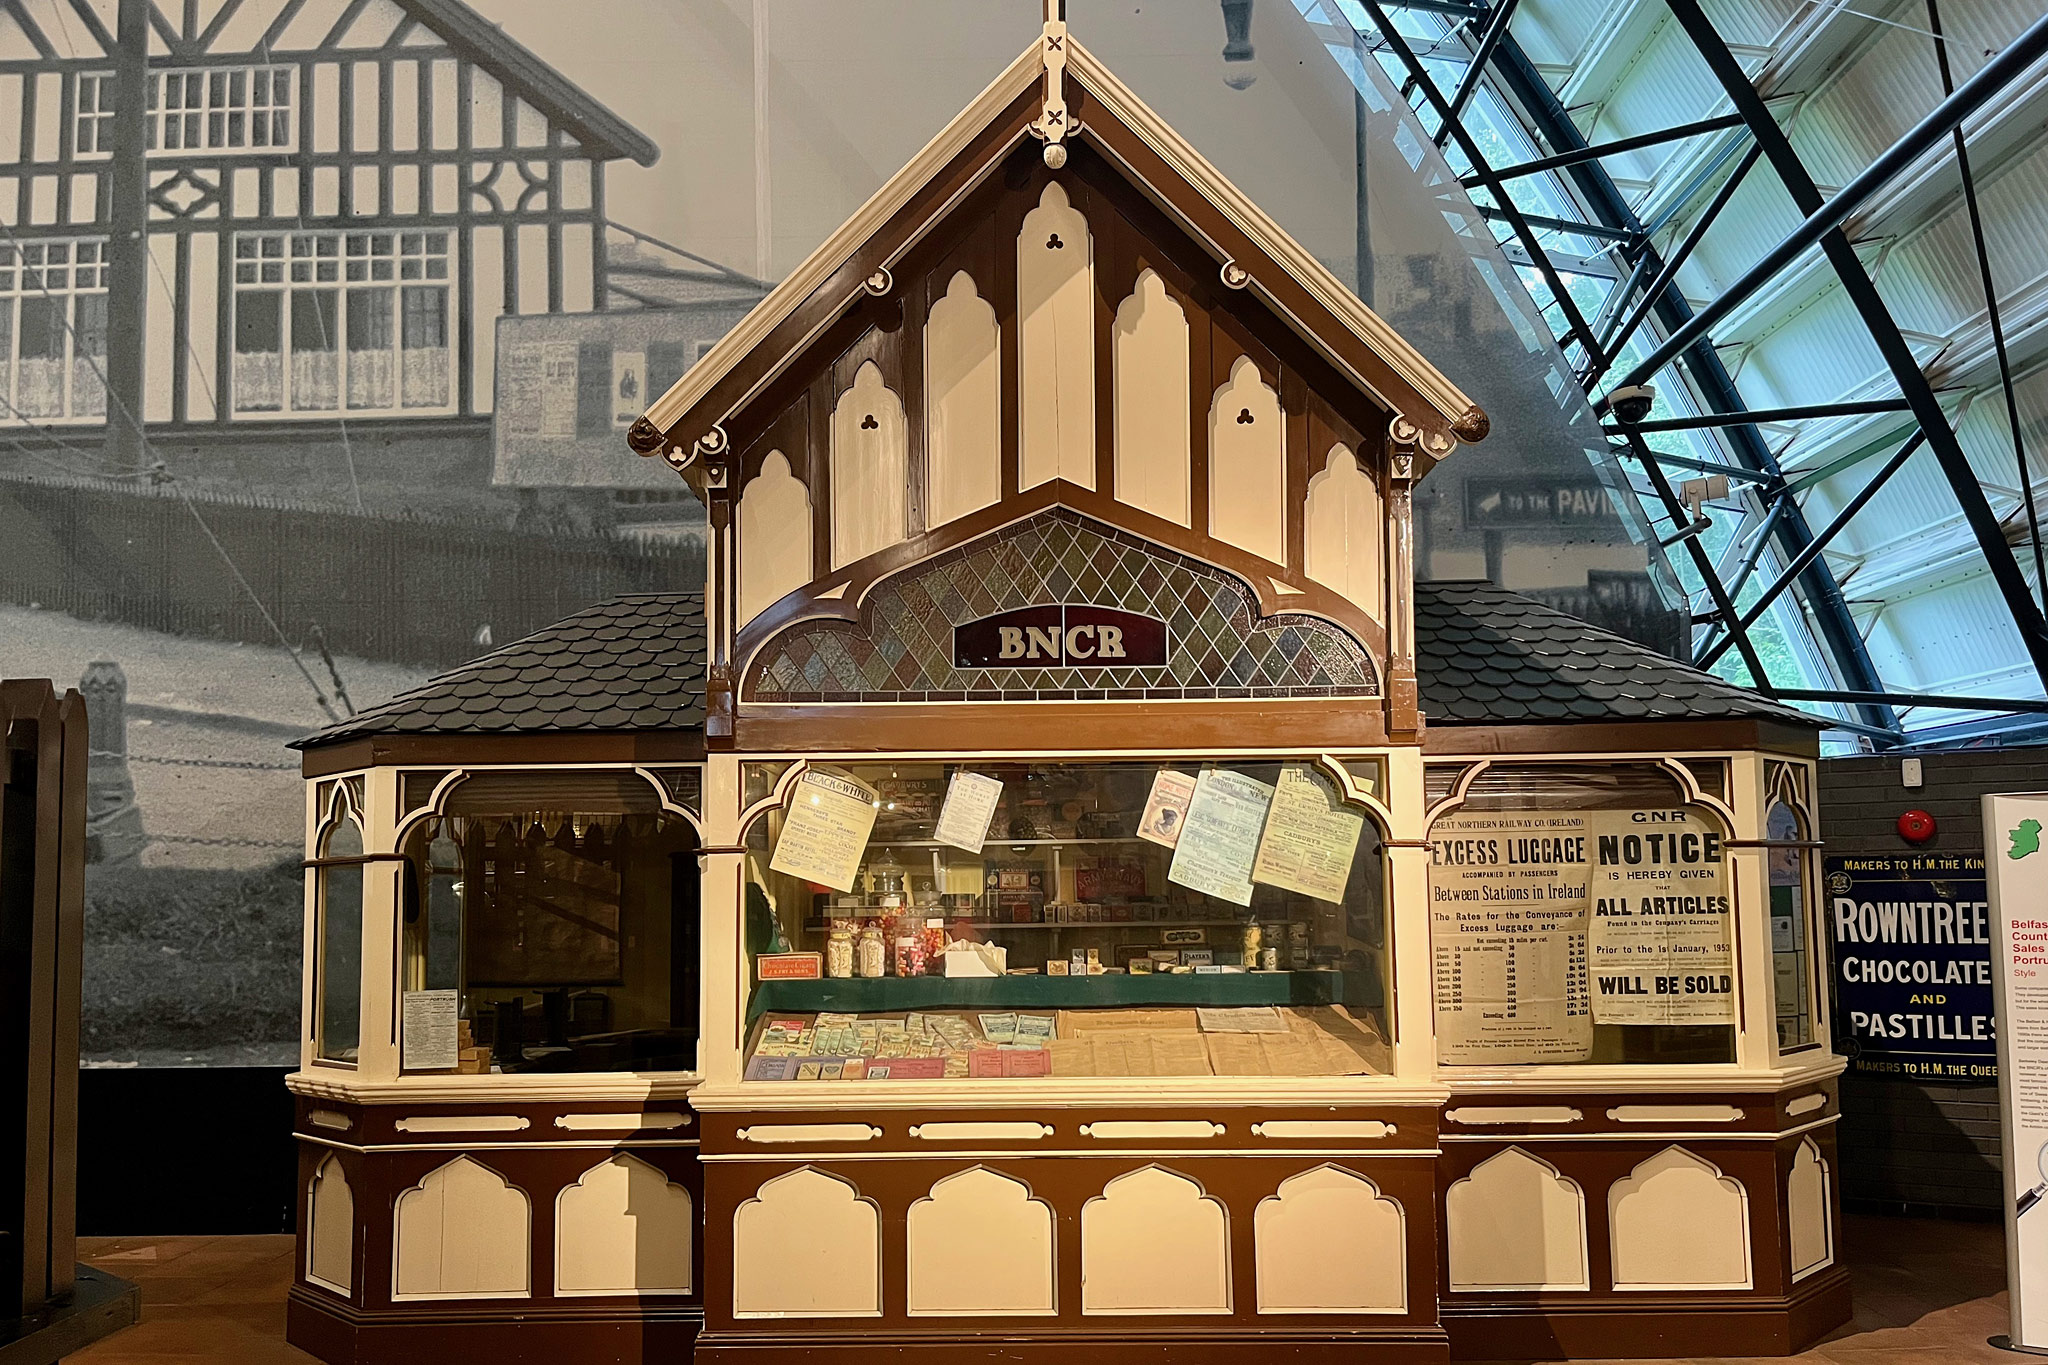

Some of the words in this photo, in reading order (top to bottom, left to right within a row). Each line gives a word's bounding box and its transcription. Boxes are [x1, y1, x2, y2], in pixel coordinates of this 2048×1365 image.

[999, 625, 1126, 659] BNCR
[1250, 790, 1269, 801] NEW
[1632, 812, 1686, 822] GNR
[1432, 822, 1455, 830] GREAT
[1500, 820, 1532, 828] RAILWAY
[1547, 819, 1584, 827] (IRELAND)
[1432, 839, 1498, 866] EXCESS
[1508, 837, 1585, 864] LUGGAGE
[1599, 833, 1720, 865] NOTICE
[1845, 860, 1890, 870] MAKERS
[1894, 860, 1908, 869] TO
[1965, 858, 1984, 869] KIN
[1608, 872, 1619, 880] IS
[1627, 871, 1672, 879] HEREBY
[1680, 870, 1714, 878] GIVEN
[1434, 886, 1479, 901] Between
[1482, 885, 1529, 900] Stations
[1533, 884, 1543, 899] in
[1548, 883, 1585, 899] Ireland
[1596, 898, 1632, 916] ALL
[1641, 896, 1729, 915] ARTICLES
[1435, 913, 1449, 921] The
[1456, 912, 1481, 920] Rates
[1487, 912, 1499, 920] for
[1506, 911, 1520, 919] the
[1526, 910, 1573, 921] Conveyance
[1578, 910, 1585, 918] of
[1834, 898, 1989, 944] ROWNTREE
[1460, 924, 1489, 932] Excess
[1496, 923, 1533, 933] Luggage
[1638, 945, 1653, 953] the
[1673, 945, 1709, 954] January,
[2013, 944, 2044, 952] Sales
[1843, 957, 1991, 984] CHOCOLATE
[2014, 969, 2036, 977] Style
[1598, 977, 1648, 994] WILL
[1656, 977, 1679, 994] BE
[1685, 975, 1731, 993] SOLD
[1910, 994, 1947, 1004] AND
[1857, 1060, 1900, 1073] MAKERS
[1904, 1063, 1917, 1073] TO
[1971, 1065, 1998, 1076] QUEE
